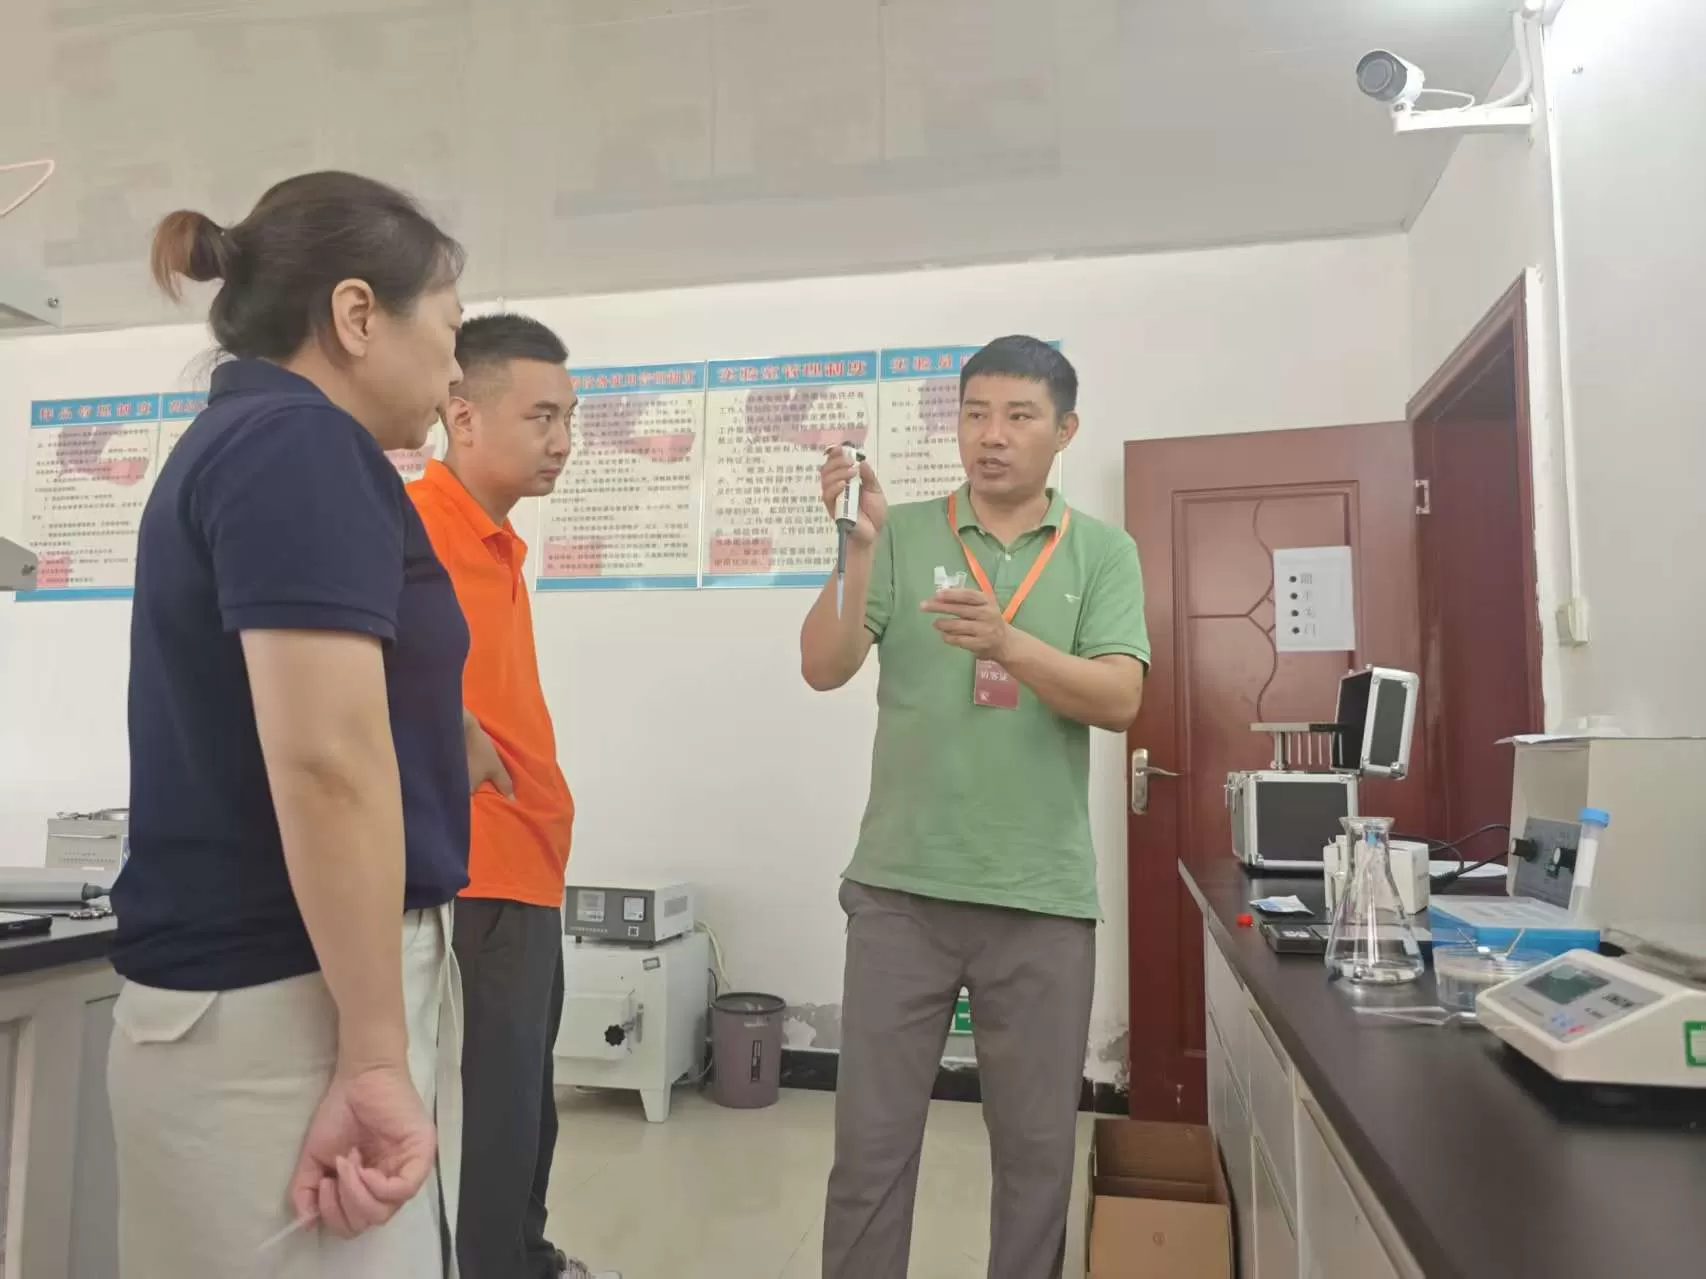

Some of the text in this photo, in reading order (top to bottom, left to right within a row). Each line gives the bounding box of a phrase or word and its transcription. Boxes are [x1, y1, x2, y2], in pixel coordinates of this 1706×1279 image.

[719, 360, 867, 382] 实验室管理制度
